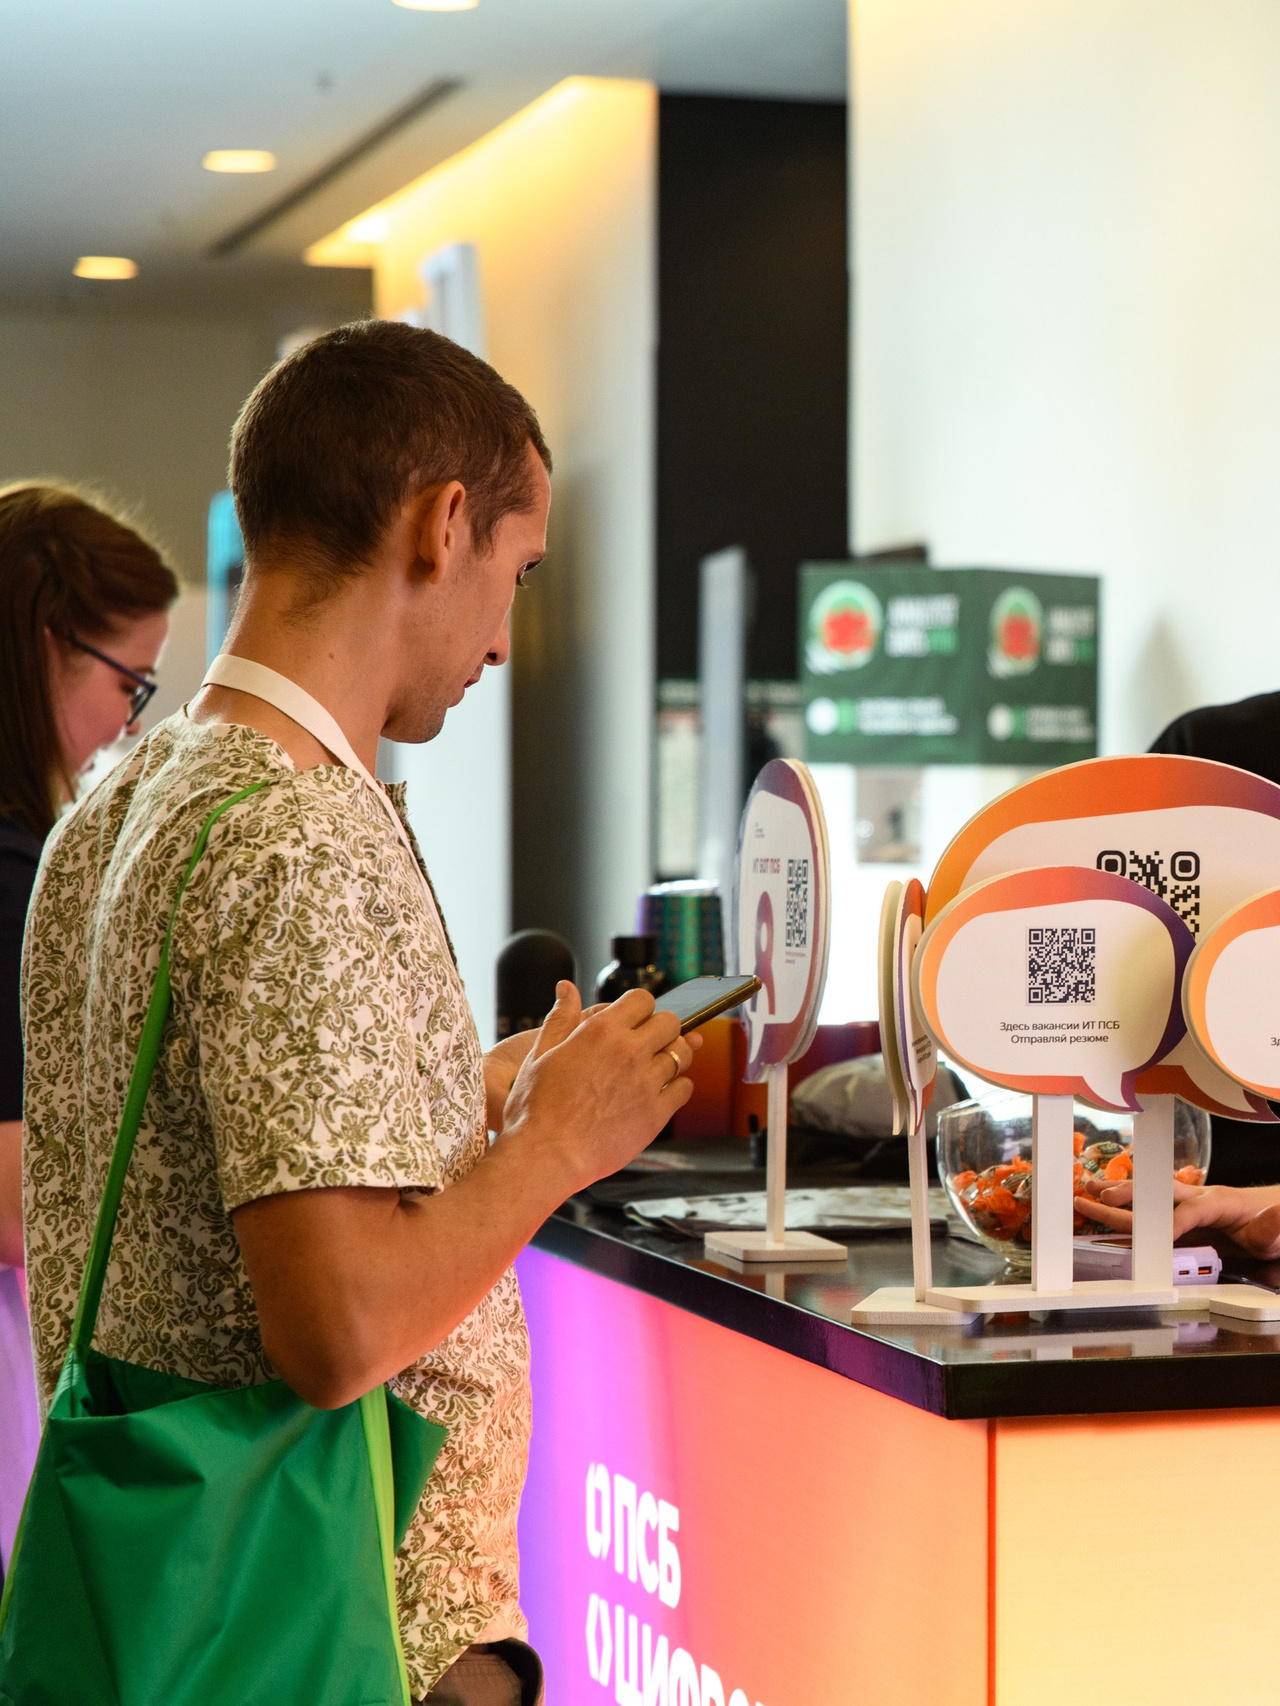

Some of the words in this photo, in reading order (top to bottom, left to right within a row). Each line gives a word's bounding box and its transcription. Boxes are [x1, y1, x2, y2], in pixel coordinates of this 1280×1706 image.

[999, 1021, 1030, 1032] Здесь
[1032, 1021, 1080, 1031] вакансии
[1082, 1020, 1097, 1030] ИТ
[1098, 1020, 1121, 1030] ПСБ
[1010, 1033, 1067, 1045] Отправляй
[1069, 1034, 1109, 1044] резюме
[613, 1473, 681, 1610] ПСБ
[614, 1604, 767, 1706] ЦИФ
